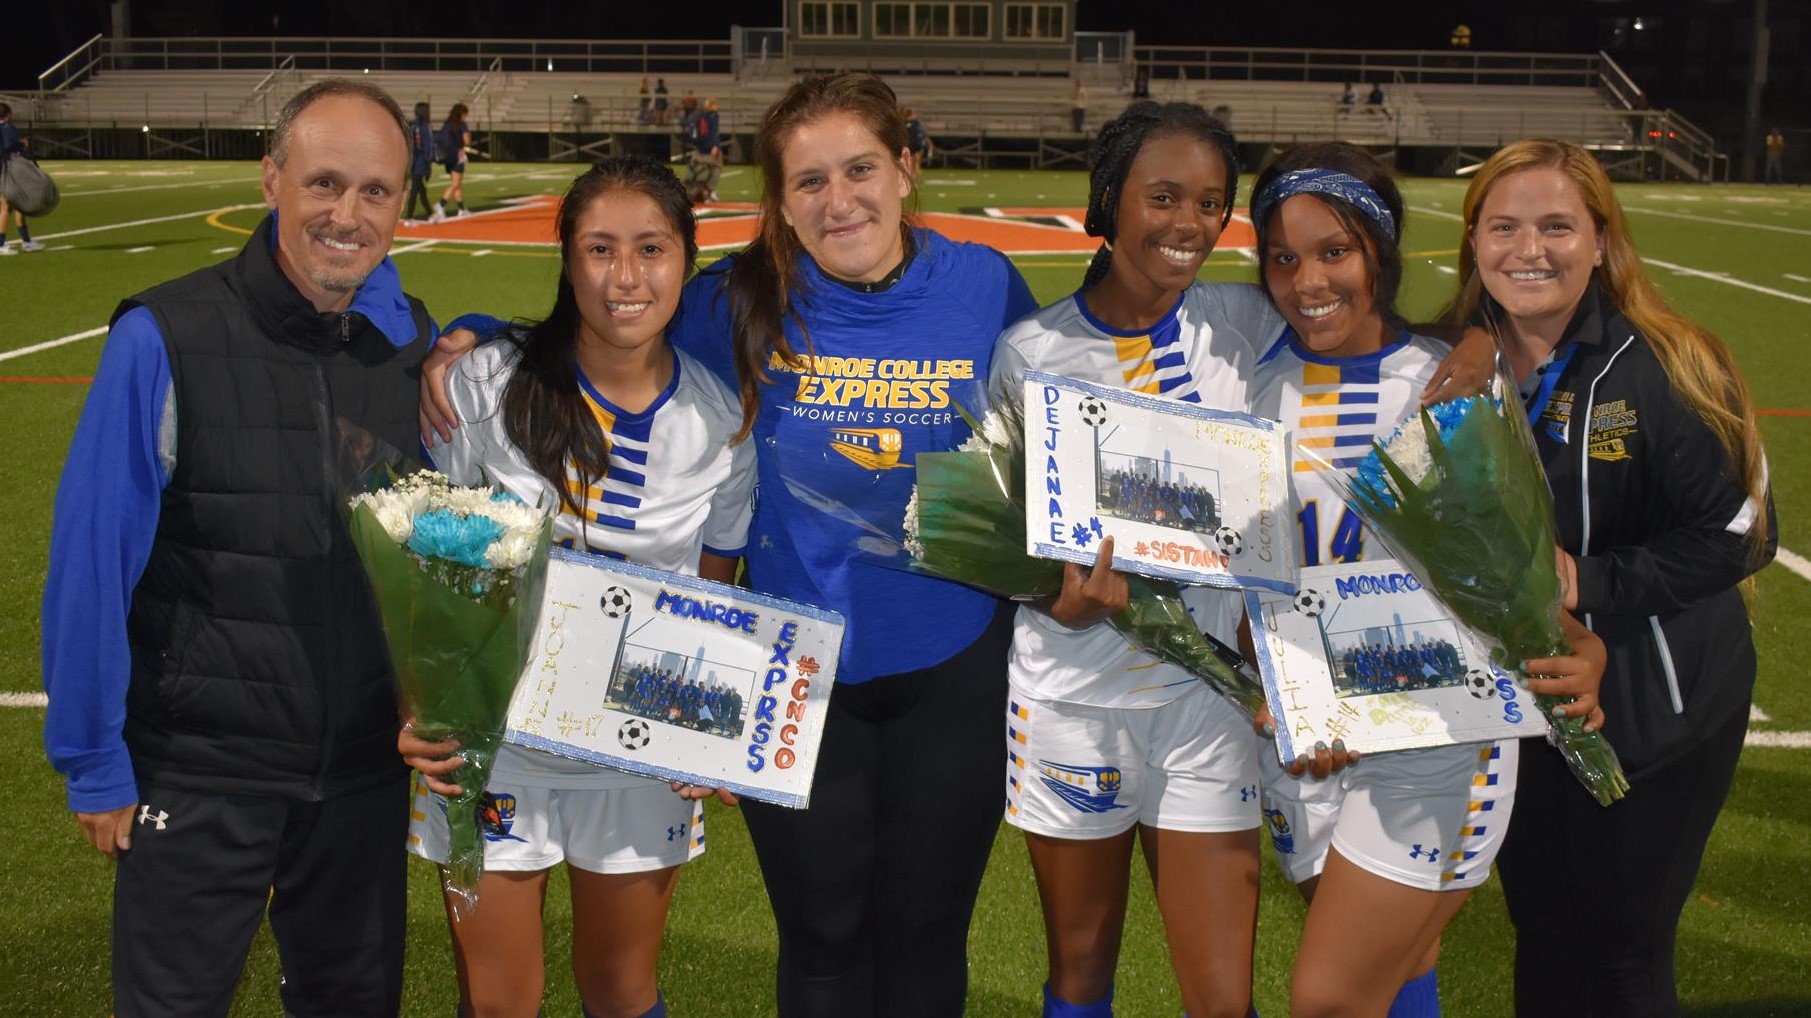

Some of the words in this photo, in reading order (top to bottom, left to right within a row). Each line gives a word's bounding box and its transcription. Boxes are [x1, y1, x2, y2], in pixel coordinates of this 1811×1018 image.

[769, 352, 876, 378] MONROE
[878, 360, 974, 379] COLLEGE
[796, 376, 950, 409] EXPRESS
[793, 405, 875, 423] WOMEN'S
[883, 412, 951, 424] SOCCER
[1589, 410, 1638, 434] PRESS
[1072, 517, 1103, 547] #4
[1296, 499, 1366, 566] 14
[1335, 572, 1421, 600] MONRO
[655, 589, 758, 634] MONROE
